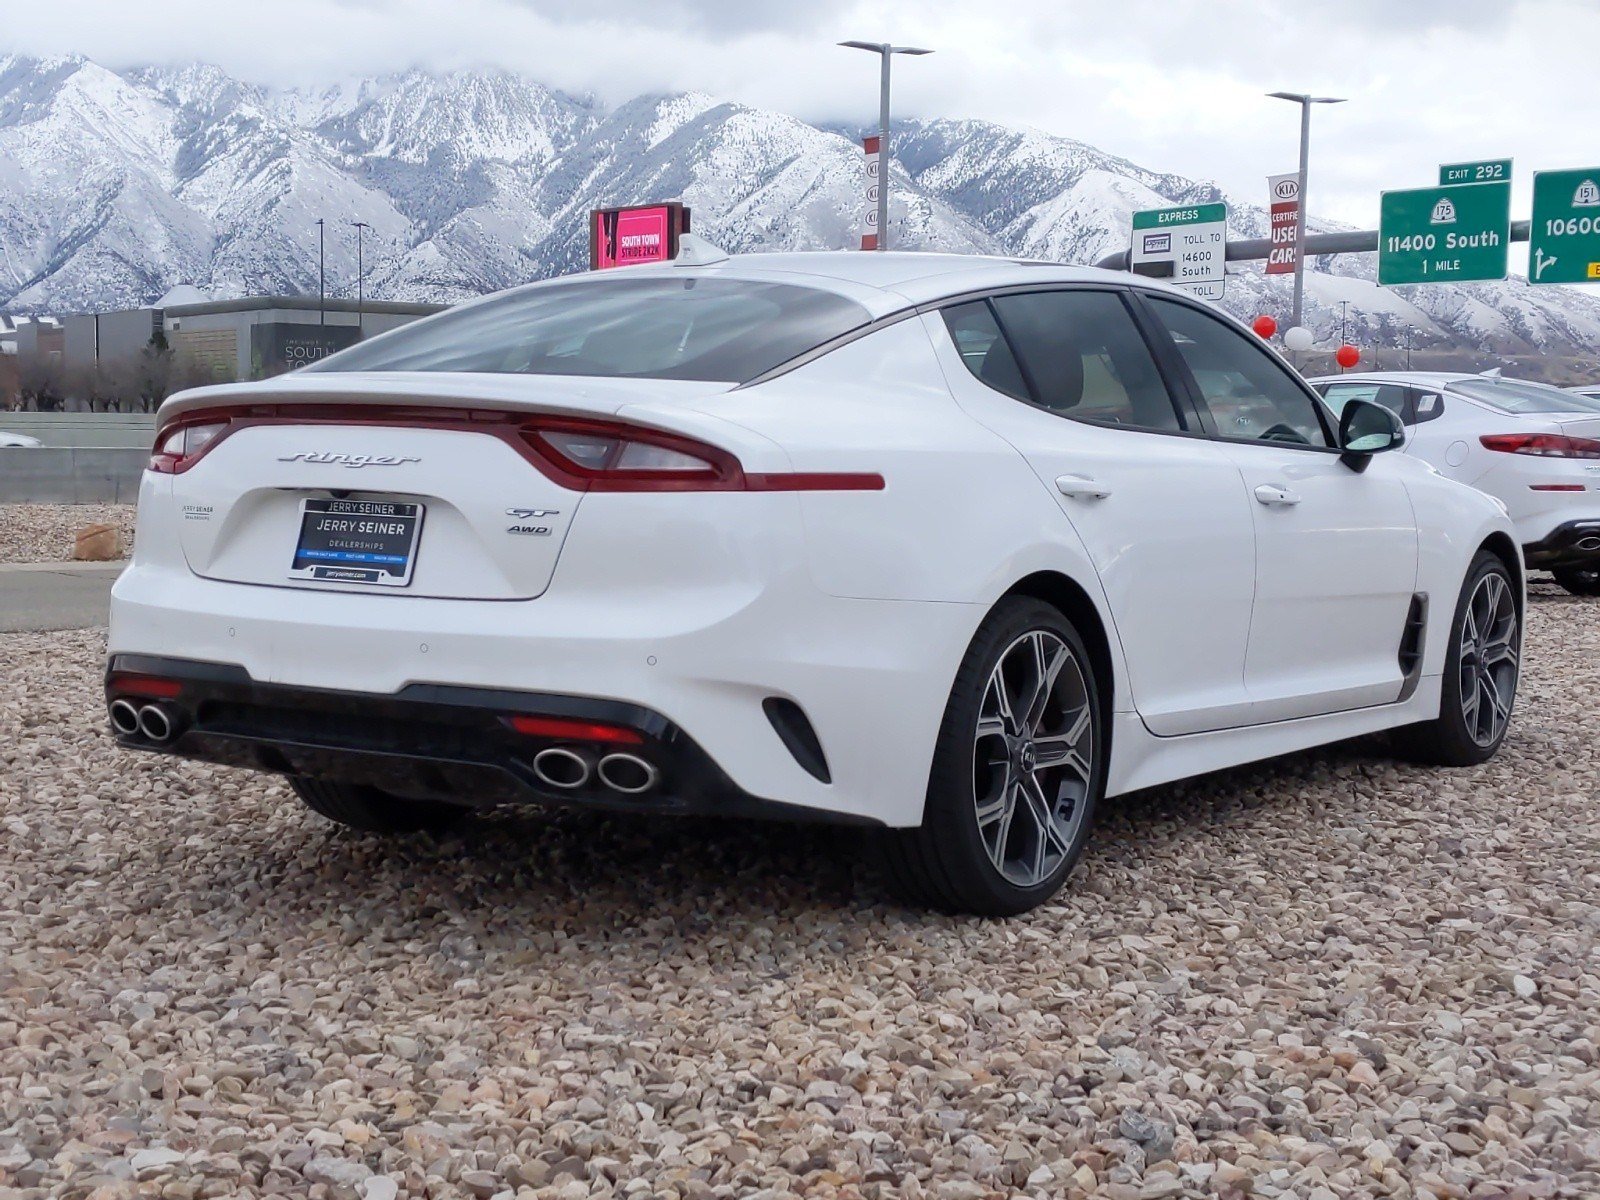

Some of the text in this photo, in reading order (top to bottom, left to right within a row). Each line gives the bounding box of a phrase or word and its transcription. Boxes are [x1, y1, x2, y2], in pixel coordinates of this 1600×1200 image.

[1448, 164, 1503, 180] EXIT 292
[1279, 184, 1296, 196] KIA
[1580, 187, 1594, 198] 151
[1158, 209, 1199, 223] EXPRESS
[1272, 210, 1299, 223] CERTIFIE
[1436, 205, 1452, 216] 175
[621, 233, 660, 247] SOUTH TOWN
[1184, 232, 1221, 245] TOLL TO
[1388, 230, 1499, 252] 11400 South
[621, 246, 642, 258] STRIDE
[1182, 251, 1212, 263] 14600
[1182, 267, 1211, 277] South
[1422, 259, 1461, 274] 1 MILE
[1193, 286, 1214, 296] TOLL
[285, 346, 336, 359] SOUTH
[329, 501, 395, 515] JERRY SEINER
[317, 519, 405, 535] JERRY SEINER
[507, 525, 549, 534] AWD
[329, 540, 384, 550] DEALERSHIPS
